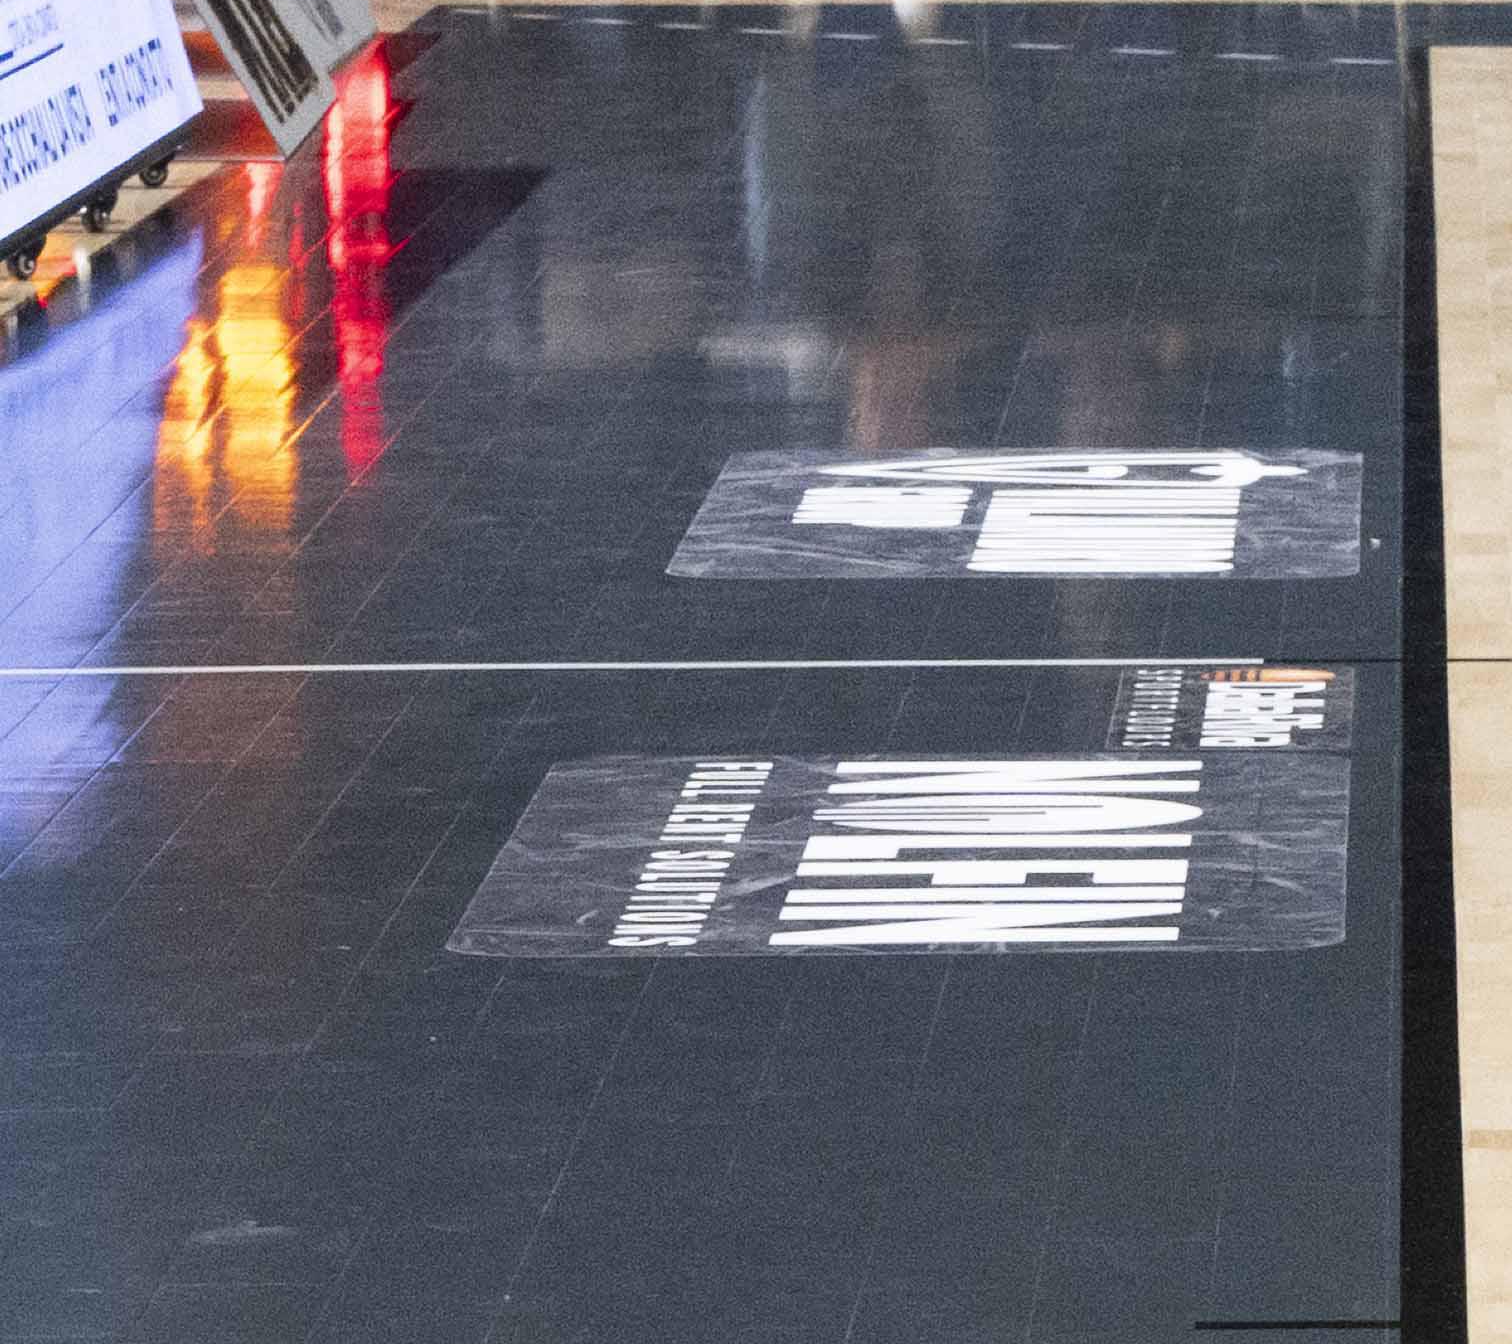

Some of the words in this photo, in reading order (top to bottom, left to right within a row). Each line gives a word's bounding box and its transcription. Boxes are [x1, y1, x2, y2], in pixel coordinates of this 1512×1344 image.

[680, 761, 774, 797] FULL
[659, 803, 756, 842] RENT
[767, 760, 1204, 946] NOLFIN
[608, 849, 736, 947] SOLUTIONS
